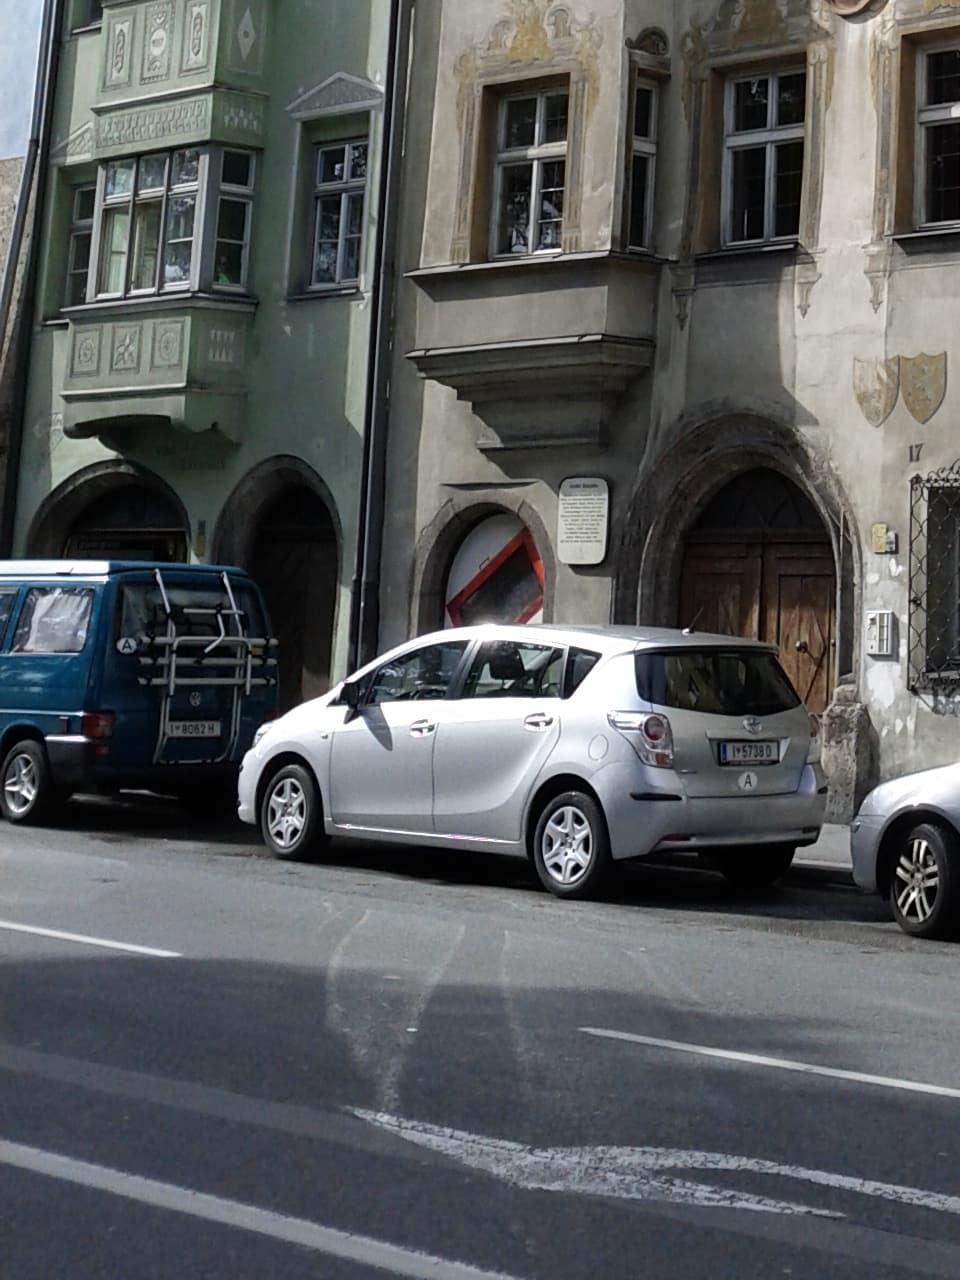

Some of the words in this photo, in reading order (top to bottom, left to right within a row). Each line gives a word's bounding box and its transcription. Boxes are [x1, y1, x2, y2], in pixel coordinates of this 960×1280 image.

[908, 442, 924, 463] 17
[122, 638, 133, 651] A
[743, 774, 752, 787] A
